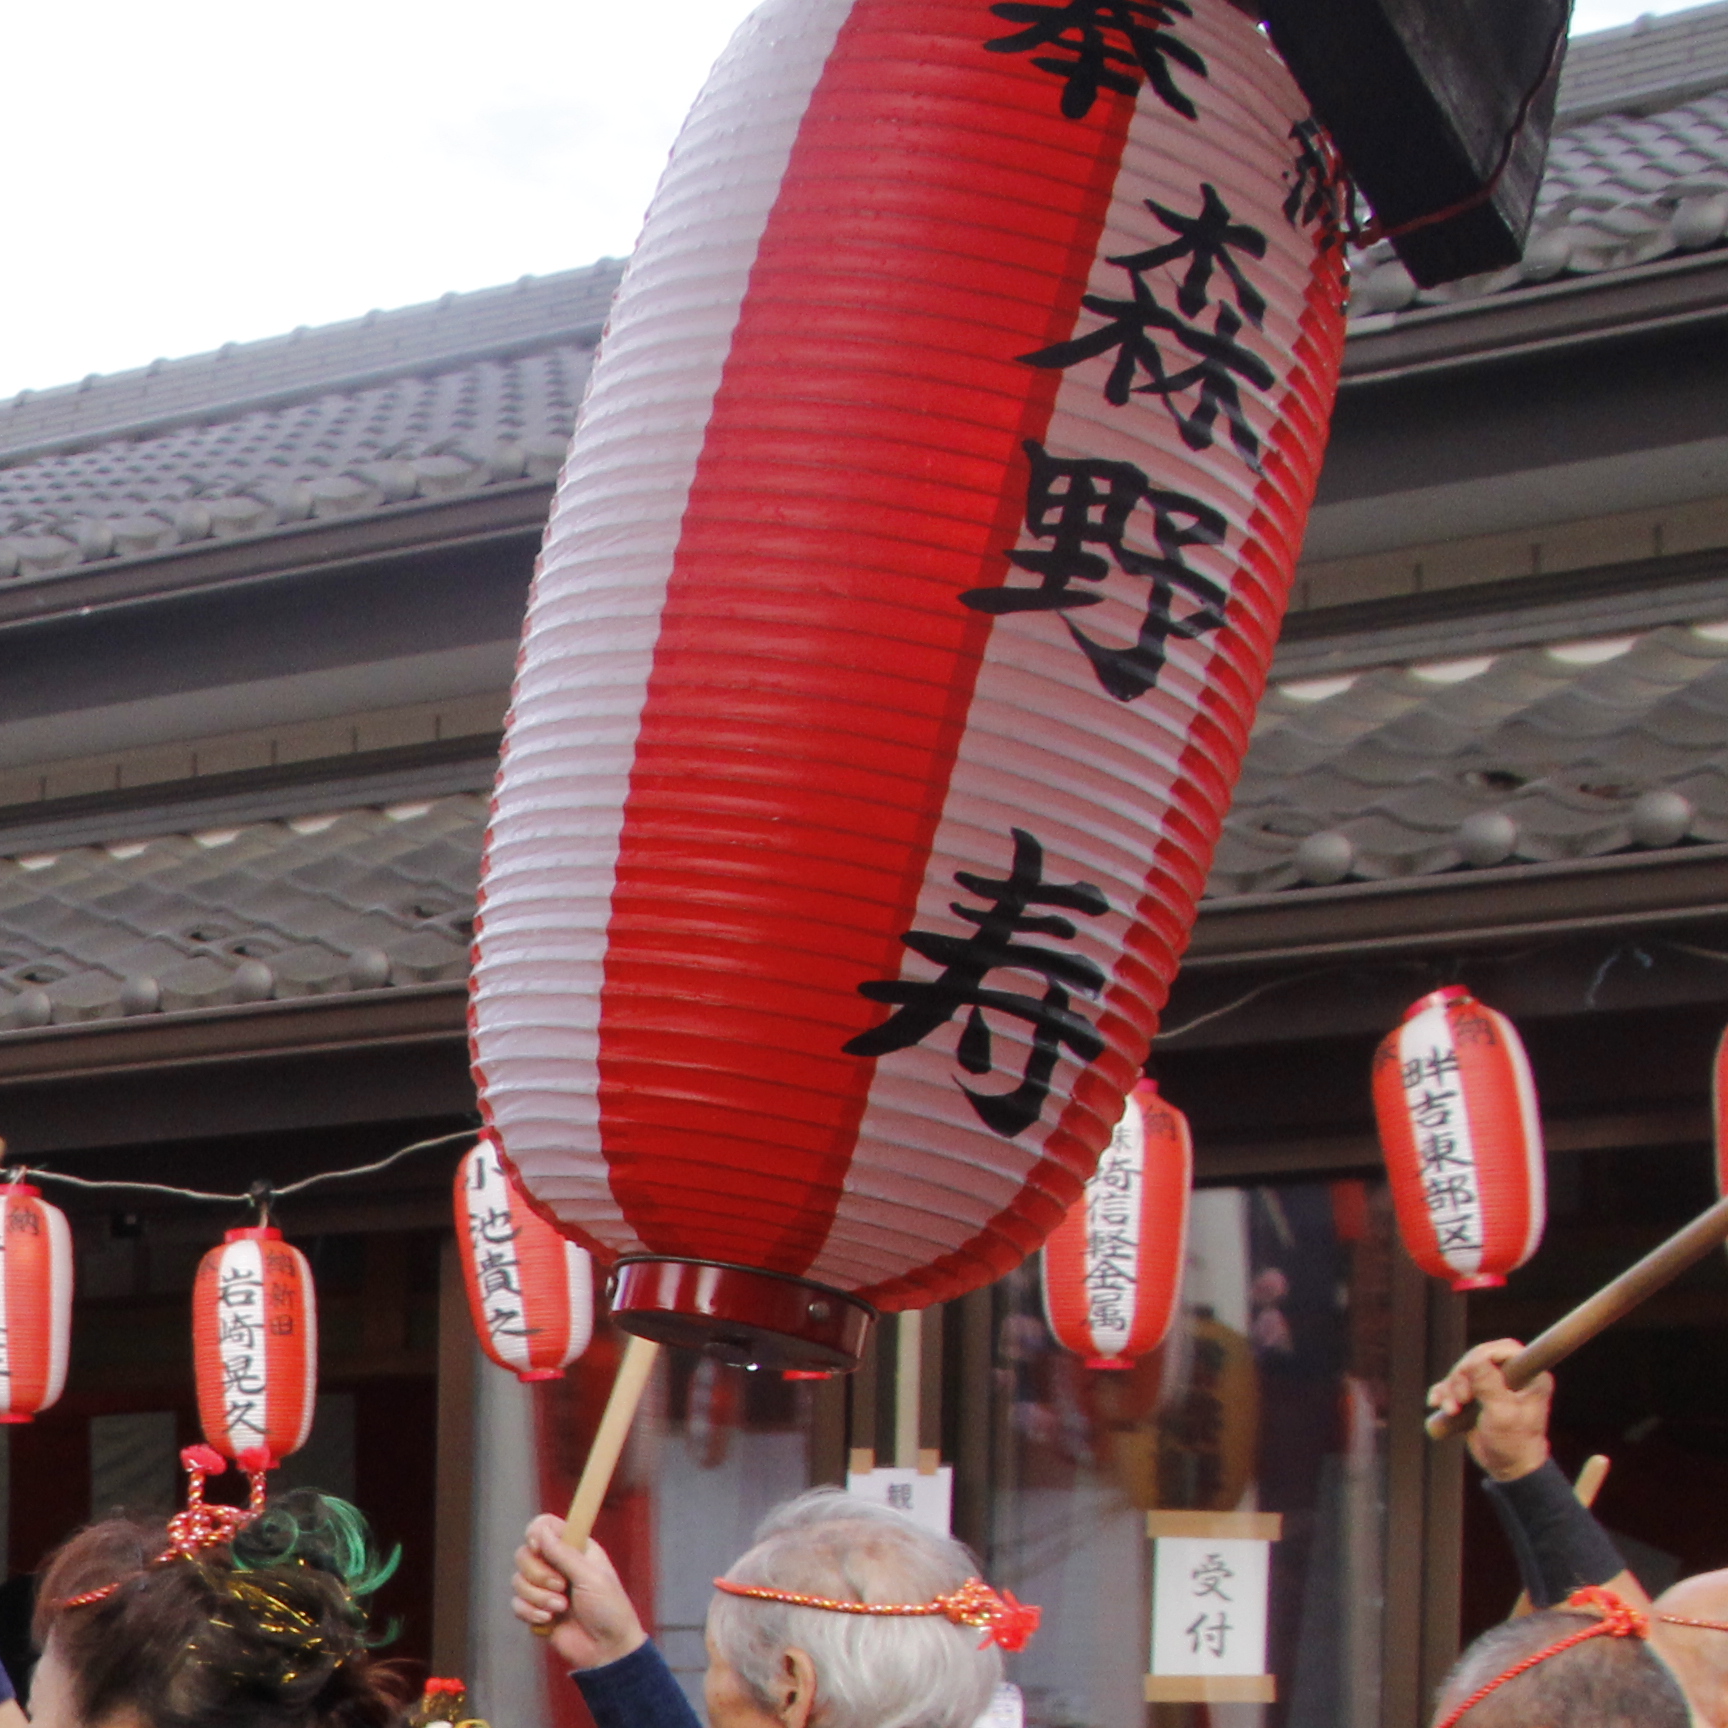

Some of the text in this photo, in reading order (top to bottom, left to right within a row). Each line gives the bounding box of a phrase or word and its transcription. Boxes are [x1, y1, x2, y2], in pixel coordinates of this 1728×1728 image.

[1401, 1046, 1485, 1253] 畔吉東部区
[217, 1266, 272, 1435] 岩崎晃久
[1185, 1552, 1235, 1657] 受付
